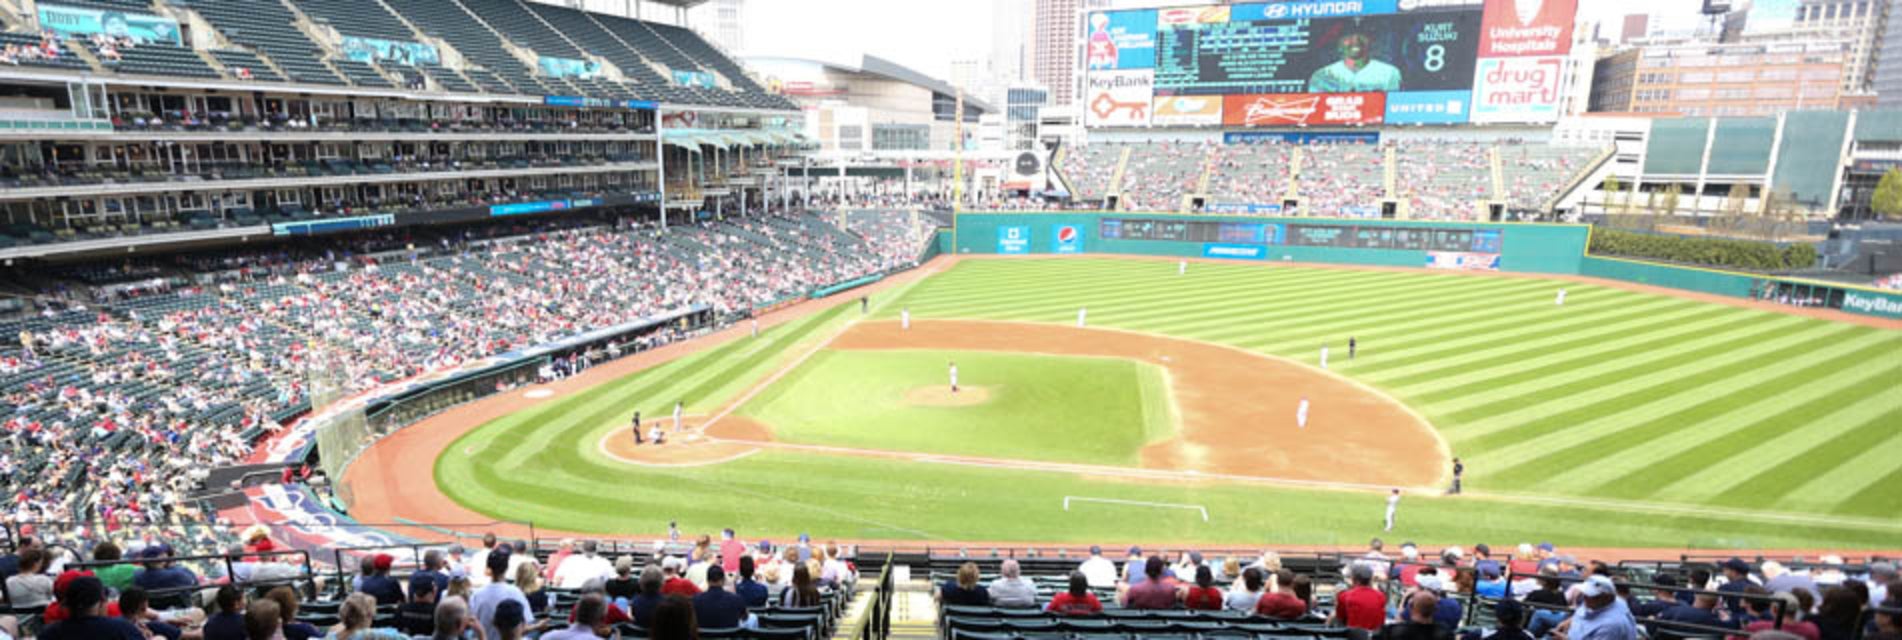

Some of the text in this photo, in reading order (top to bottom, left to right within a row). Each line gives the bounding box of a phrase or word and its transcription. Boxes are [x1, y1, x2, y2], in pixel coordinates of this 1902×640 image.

[1291, 1, 1362, 16] HYUNDAI
[1424, 44, 1446, 72] 8
[1089, 75, 1150, 88] KeyBank
[1487, 60, 1547, 89] drug
[1488, 87, 1556, 104] mart
[1391, 103, 1444, 113] UNITED
